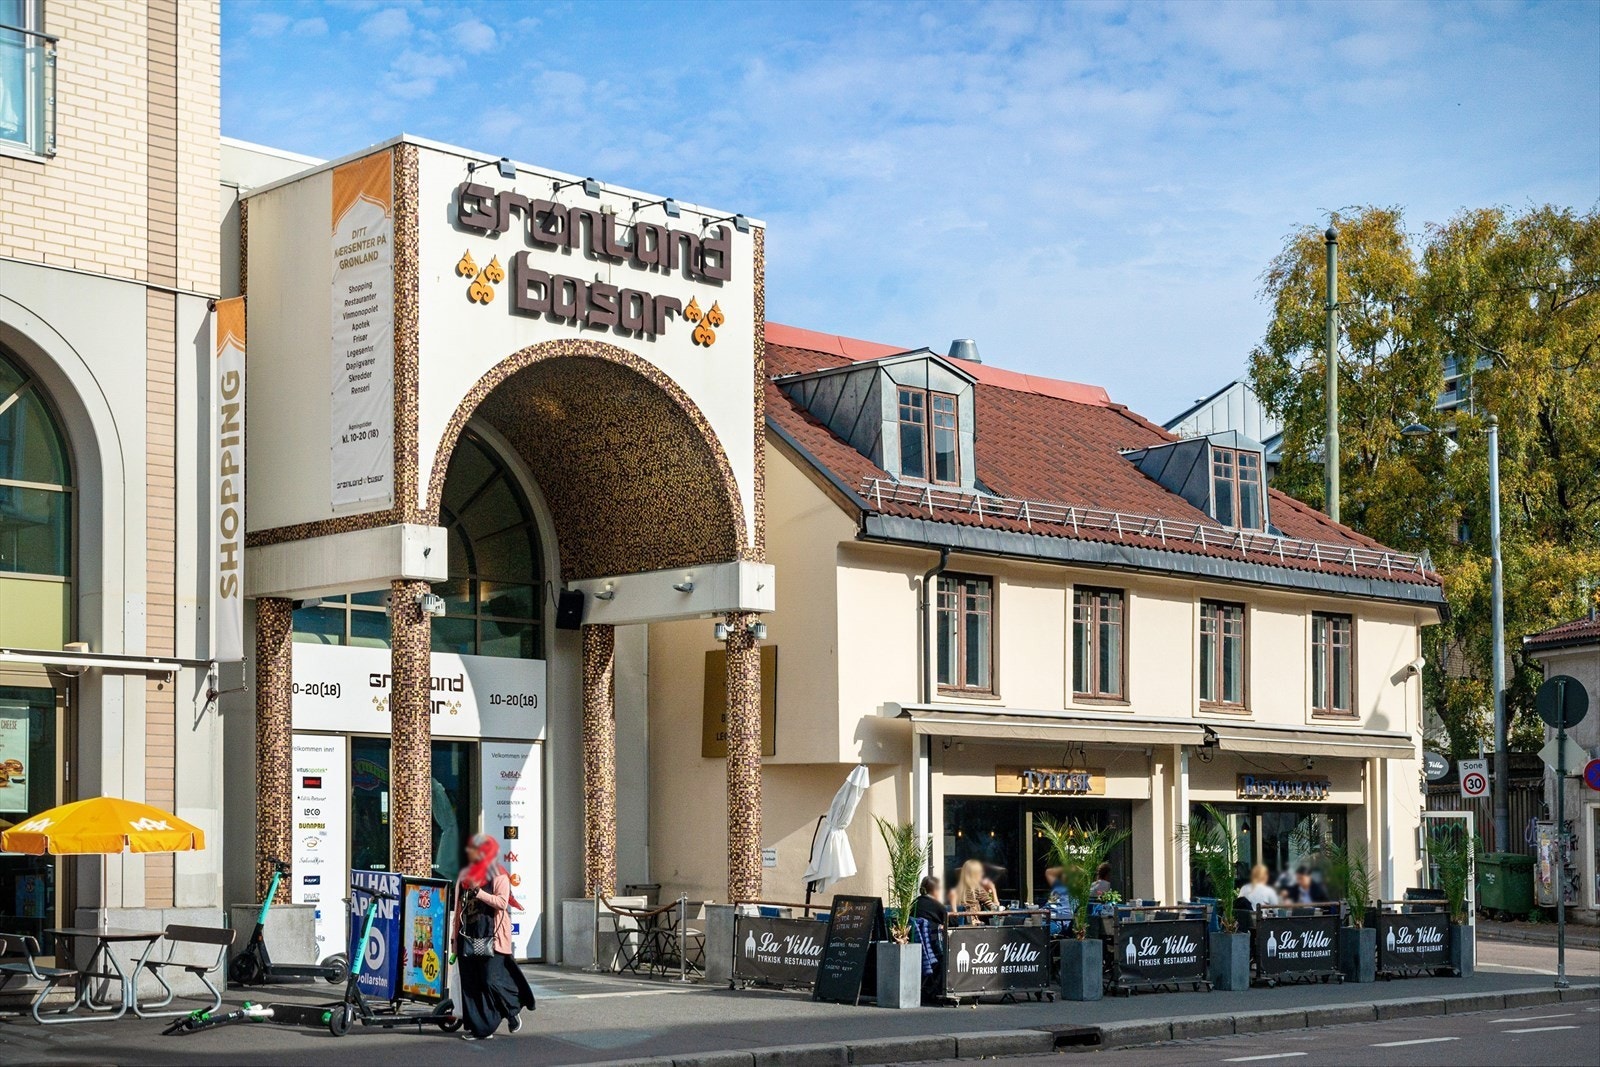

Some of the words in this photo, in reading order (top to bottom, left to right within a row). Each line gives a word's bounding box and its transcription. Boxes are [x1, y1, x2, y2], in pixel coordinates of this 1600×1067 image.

[352, 226, 368, 240] DITT
[376, 233, 386, 245] PÅ
[339, 250, 378, 270] GRØNLAND
[348, 281, 372, 294] Shopping
[515, 251, 683, 336] basar
[344, 293, 376, 307] Restauranter
[352, 320, 370, 332] Apotek
[348, 371, 372, 382] Skredder
[350, 432, 366, 442] 10-20
[220, 370, 240, 599] SHOPPING
[292, 683, 341, 698] 0-20(18)
[1464, 762, 1483, 770] Sone
[1468, 778, 1482, 790] 30
[128, 817, 176, 832] MAX
[504, 851, 518, 862] MAX
[368, 874, 400, 896] HAR
[352, 892, 399, 920] ÅPNT
[1278, 930, 1300, 950] La
[1300, 930, 1332, 948] Villa
[1396, 926, 1414, 944] La
[1416, 926, 1444, 944] Villa
[757, 932, 782, 953] La
[784, 934, 823, 956] Villa
[1138, 936, 1161, 956] La
[1162, 935, 1198, 954] Villa
[757, 954, 781, 964] TYRKISK
[971, 942, 998, 964] La
[1000, 942, 1040, 963] Villa
[1301, 950, 1331, 958] RESTAURANT
[1138, 958, 1160, 966] TYRKISK
[1163, 956, 1197, 964] RESTAURANT
[972, 966, 998, 974] TYRKISK
[1000, 964, 1039, 973] RESTAURANT
